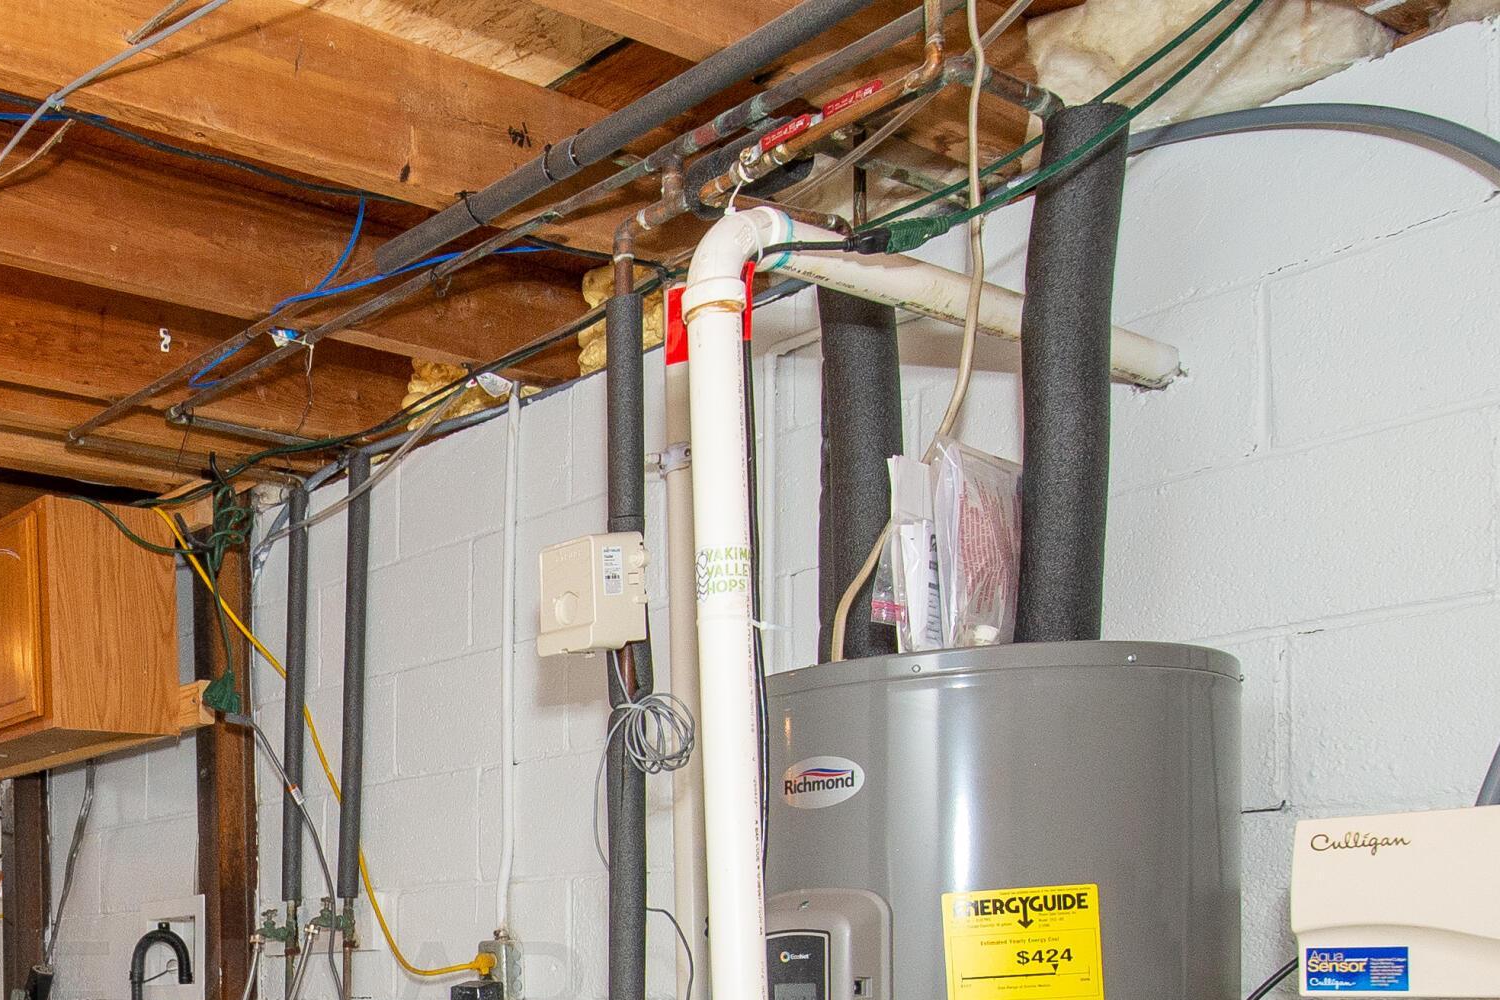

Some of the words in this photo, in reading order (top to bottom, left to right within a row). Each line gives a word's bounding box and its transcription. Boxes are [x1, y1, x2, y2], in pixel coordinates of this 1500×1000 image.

[707, 563, 749, 577] VALLE
[707, 579, 746, 594] HOPS
[784, 769, 854, 795] Richmond
[1310, 832, 1412, 856] Culligan
[1016, 948, 1073, 966] $424
[1310, 950, 1344, 962] Aqua
[1308, 959, 1367, 973] Sensor
[1309, 977, 1356, 990] Culligan
